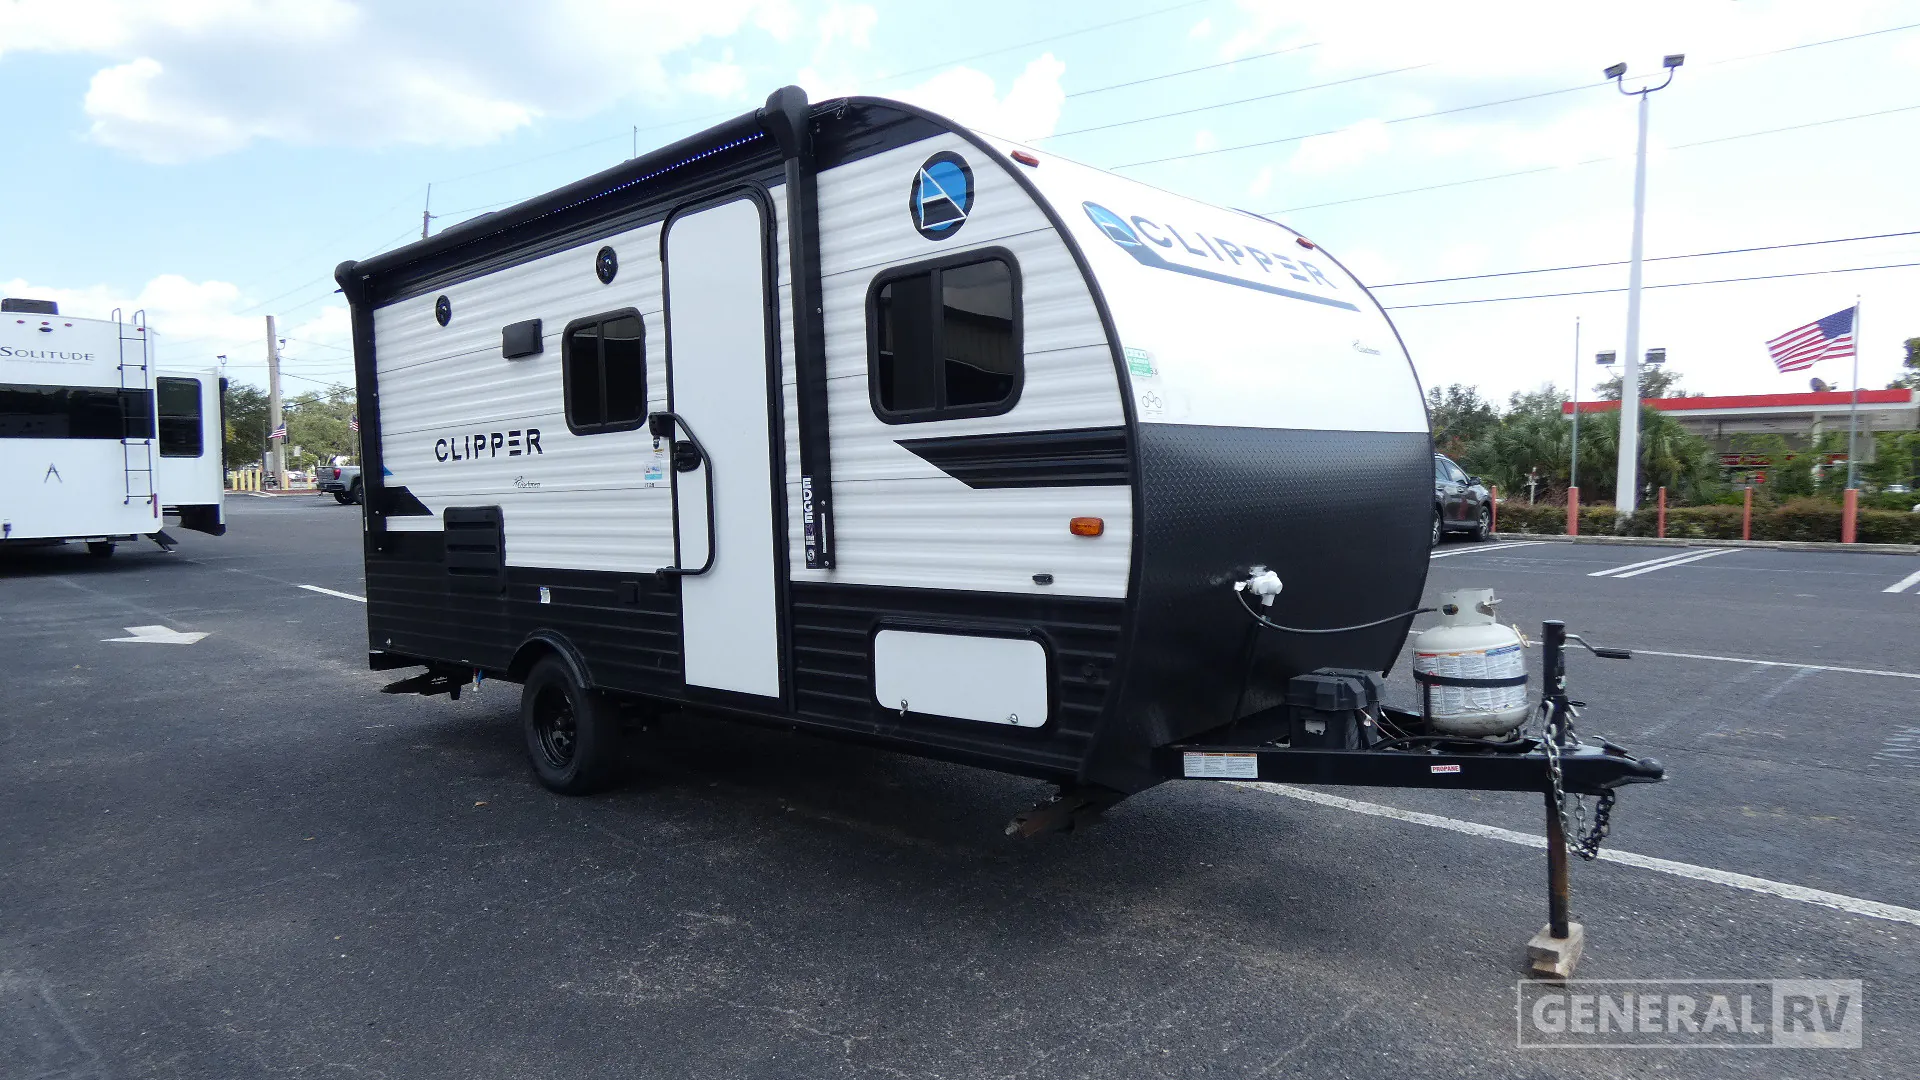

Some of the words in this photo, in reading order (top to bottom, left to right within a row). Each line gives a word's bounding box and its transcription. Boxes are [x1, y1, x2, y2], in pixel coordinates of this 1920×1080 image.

[1130, 215, 1338, 289] CLIPPER
[0, 346, 95, 361] SOLITUDE
[434, 428, 544, 462] CLIPPER
[802, 477, 814, 524] EDGE
[1432, 765, 1459, 773] PROPANE
